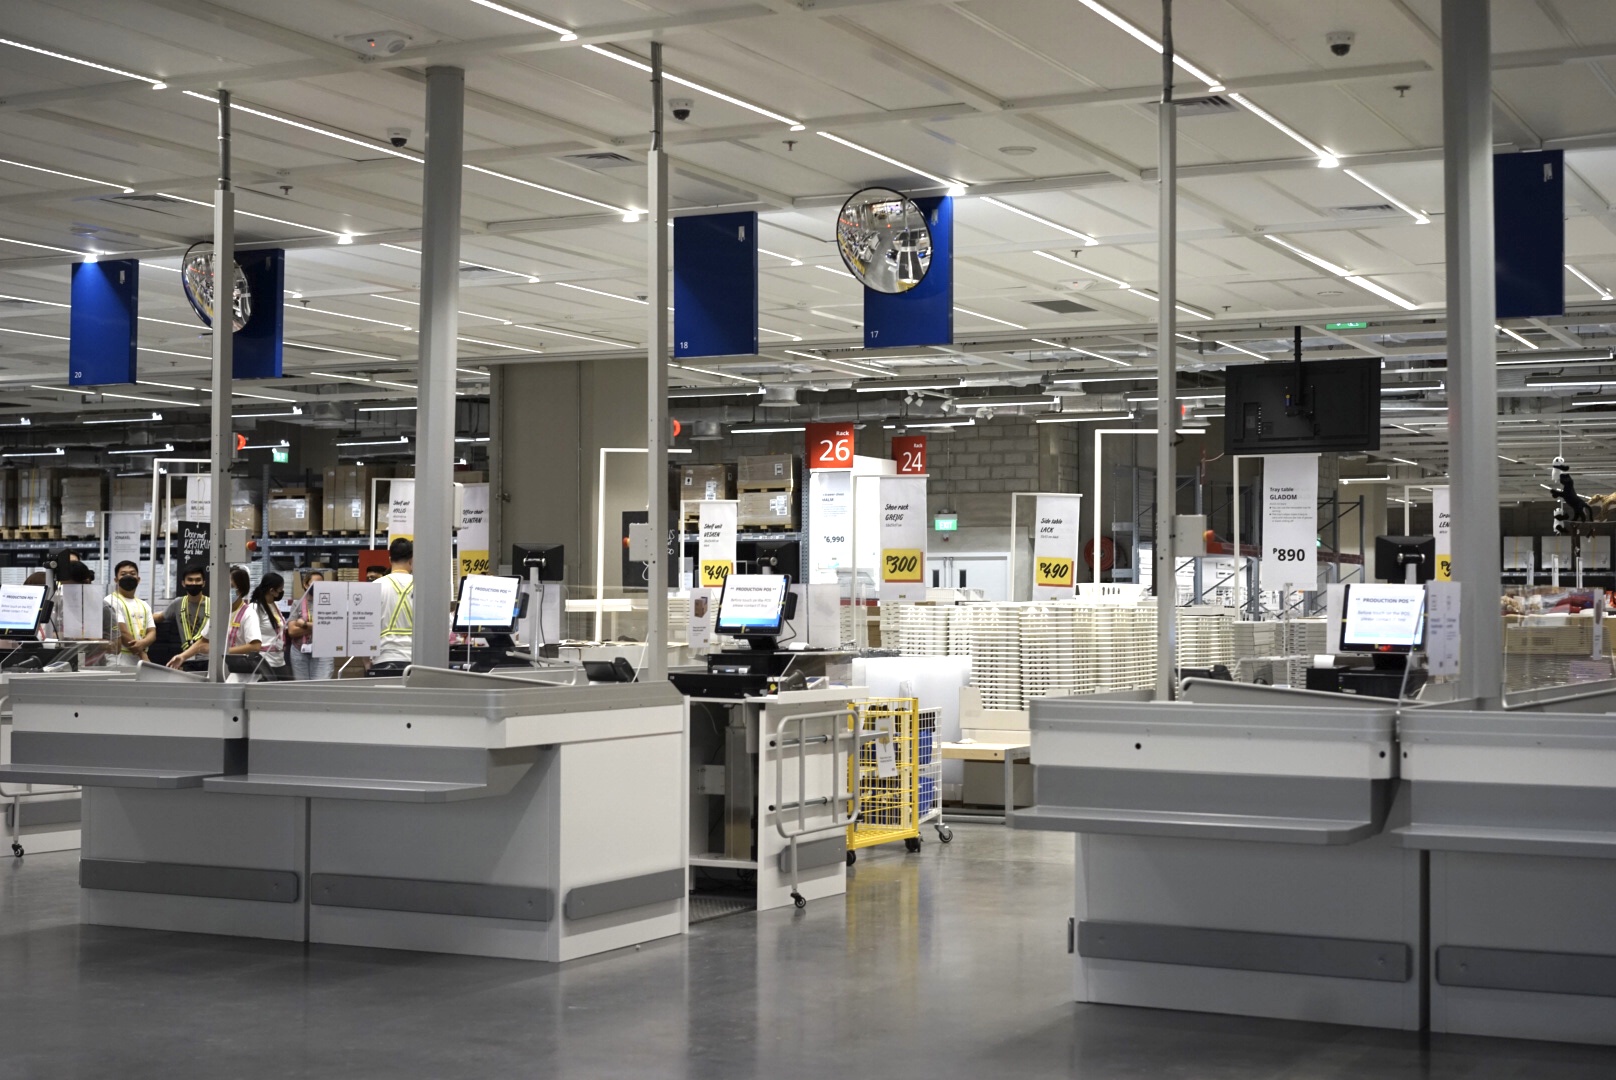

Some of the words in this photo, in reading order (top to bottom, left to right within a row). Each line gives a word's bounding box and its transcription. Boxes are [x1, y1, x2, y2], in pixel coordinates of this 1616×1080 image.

[870, 330, 879, 339] 17
[680, 341, 689, 349] 18
[74, 371, 82, 379] 20
[819, 439, 850, 461] 26
[902, 451, 923, 472] 24
[885, 503, 897, 511] Shoe
